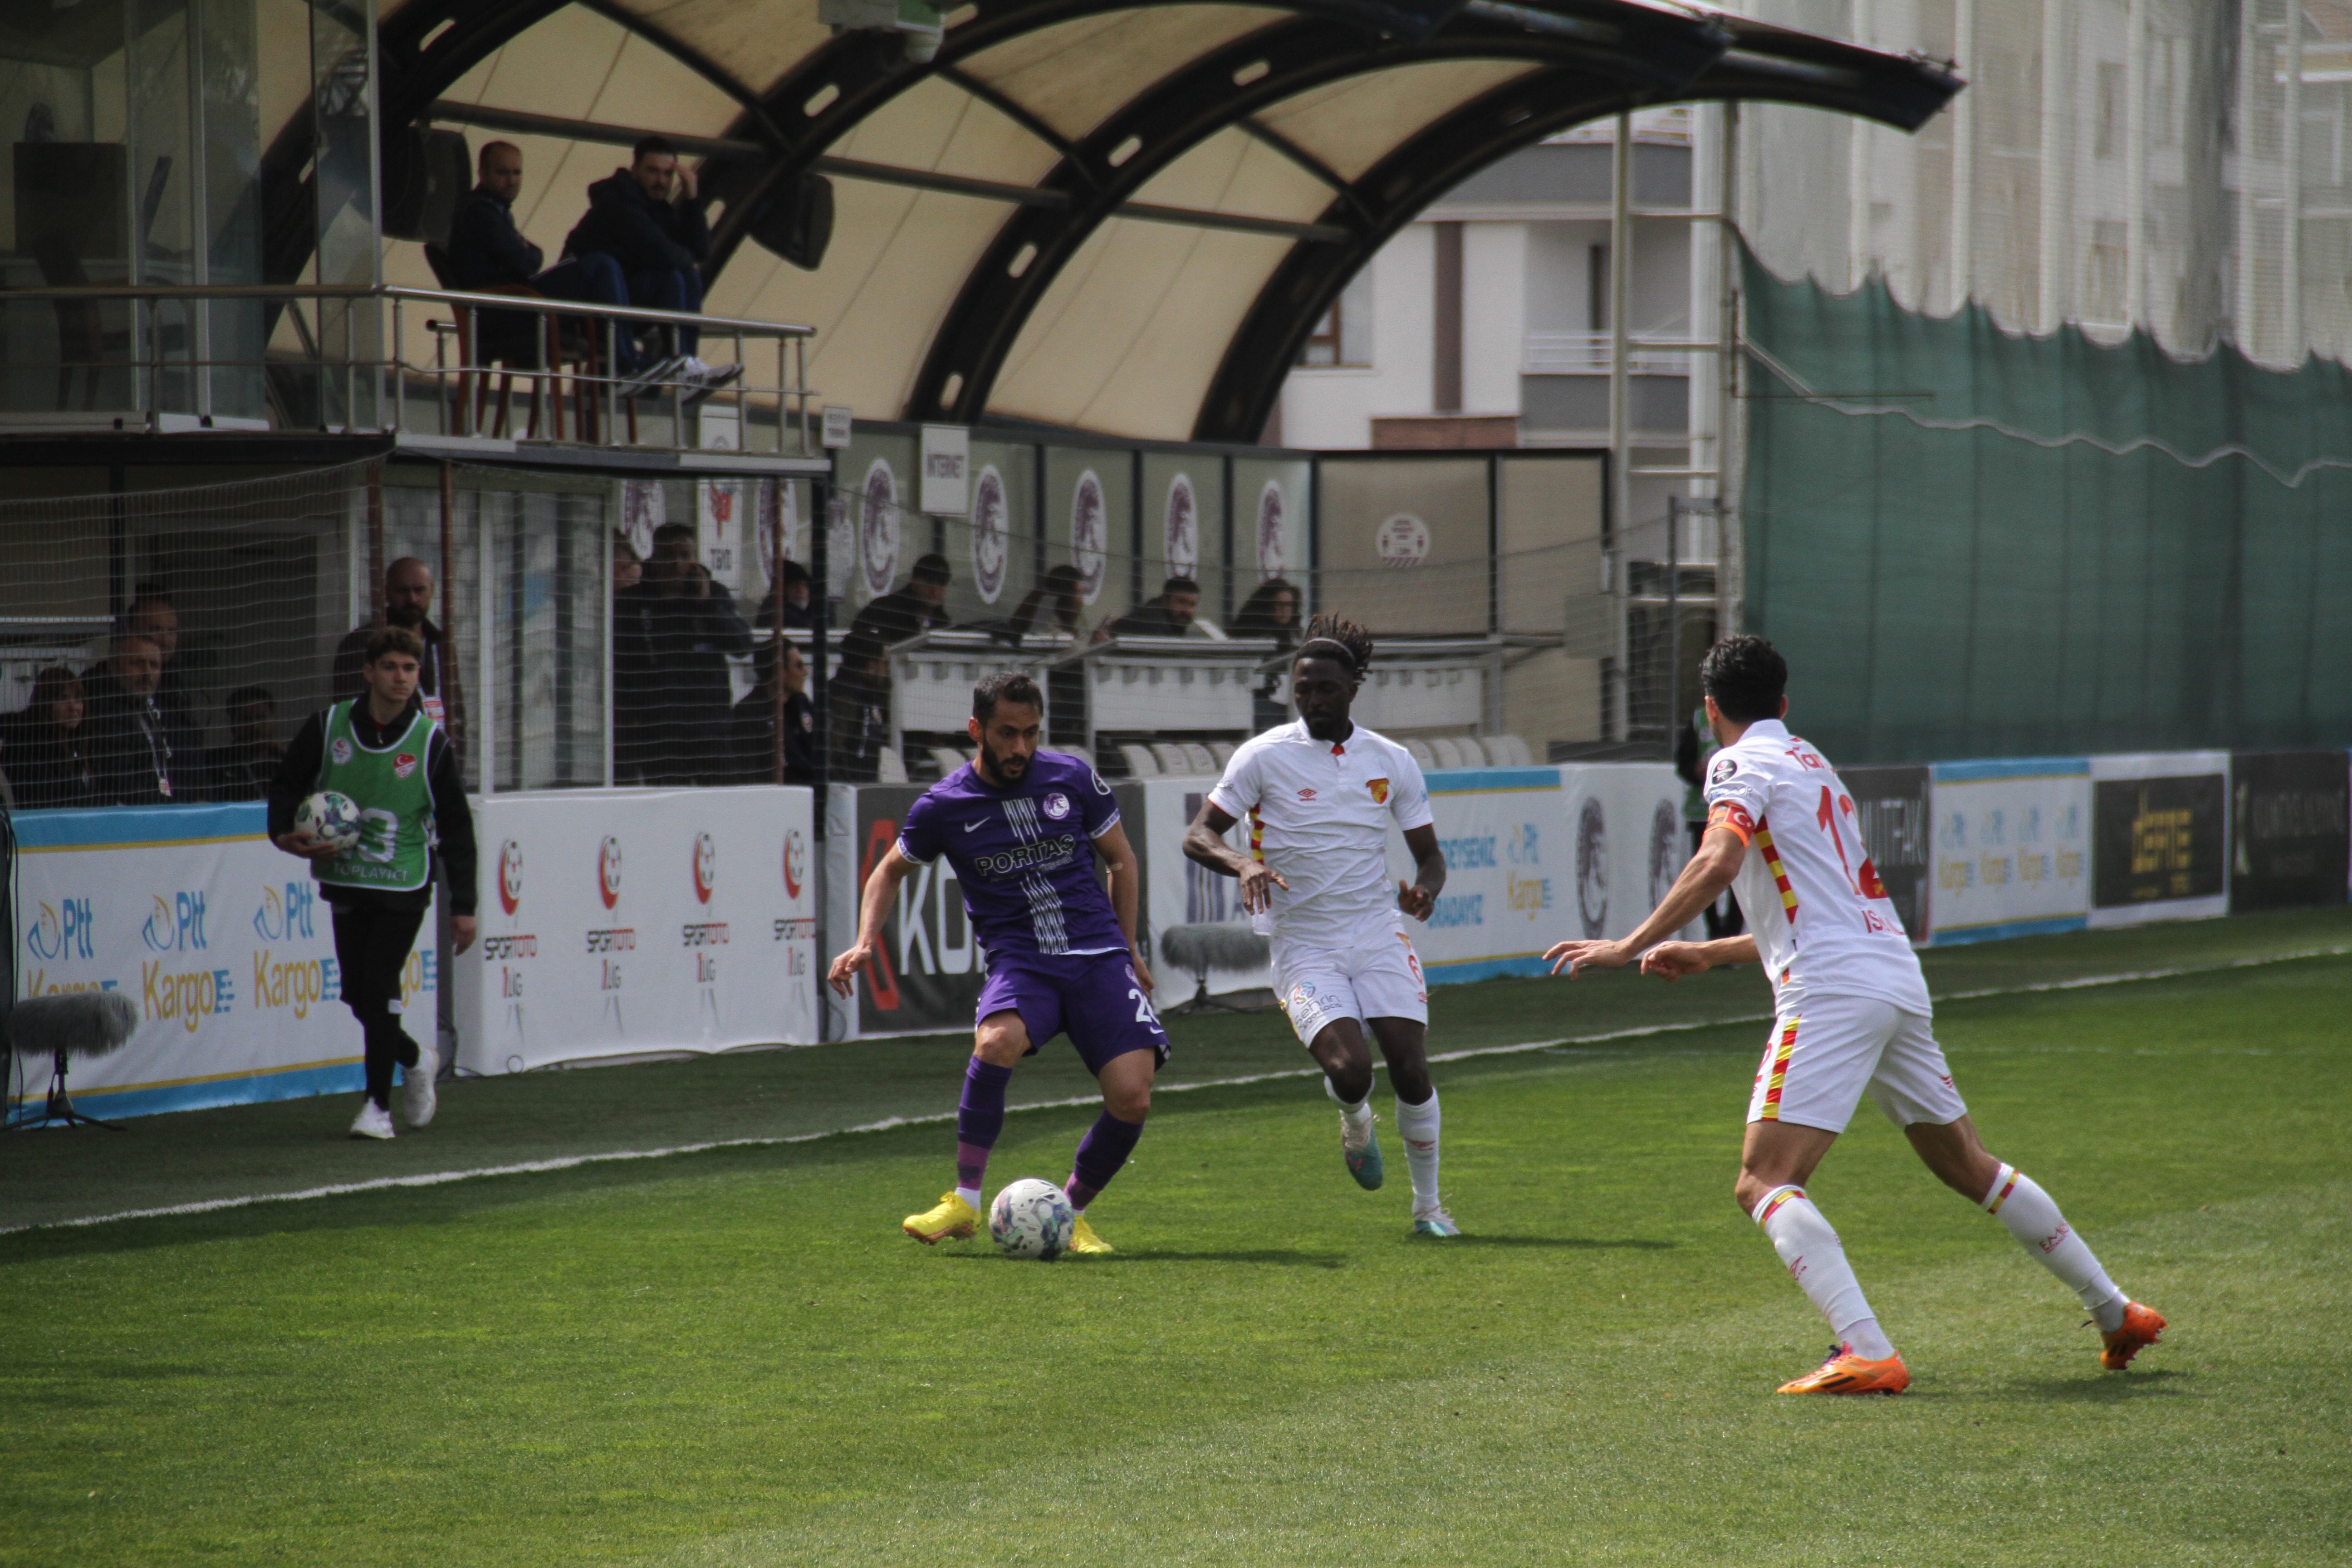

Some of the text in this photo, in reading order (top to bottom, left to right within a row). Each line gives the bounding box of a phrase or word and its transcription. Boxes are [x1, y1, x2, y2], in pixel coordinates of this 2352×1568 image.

[63, 898, 93, 960] Ptt
[176, 891, 207, 951] Ptt
[286, 881, 314, 941] Ptt
